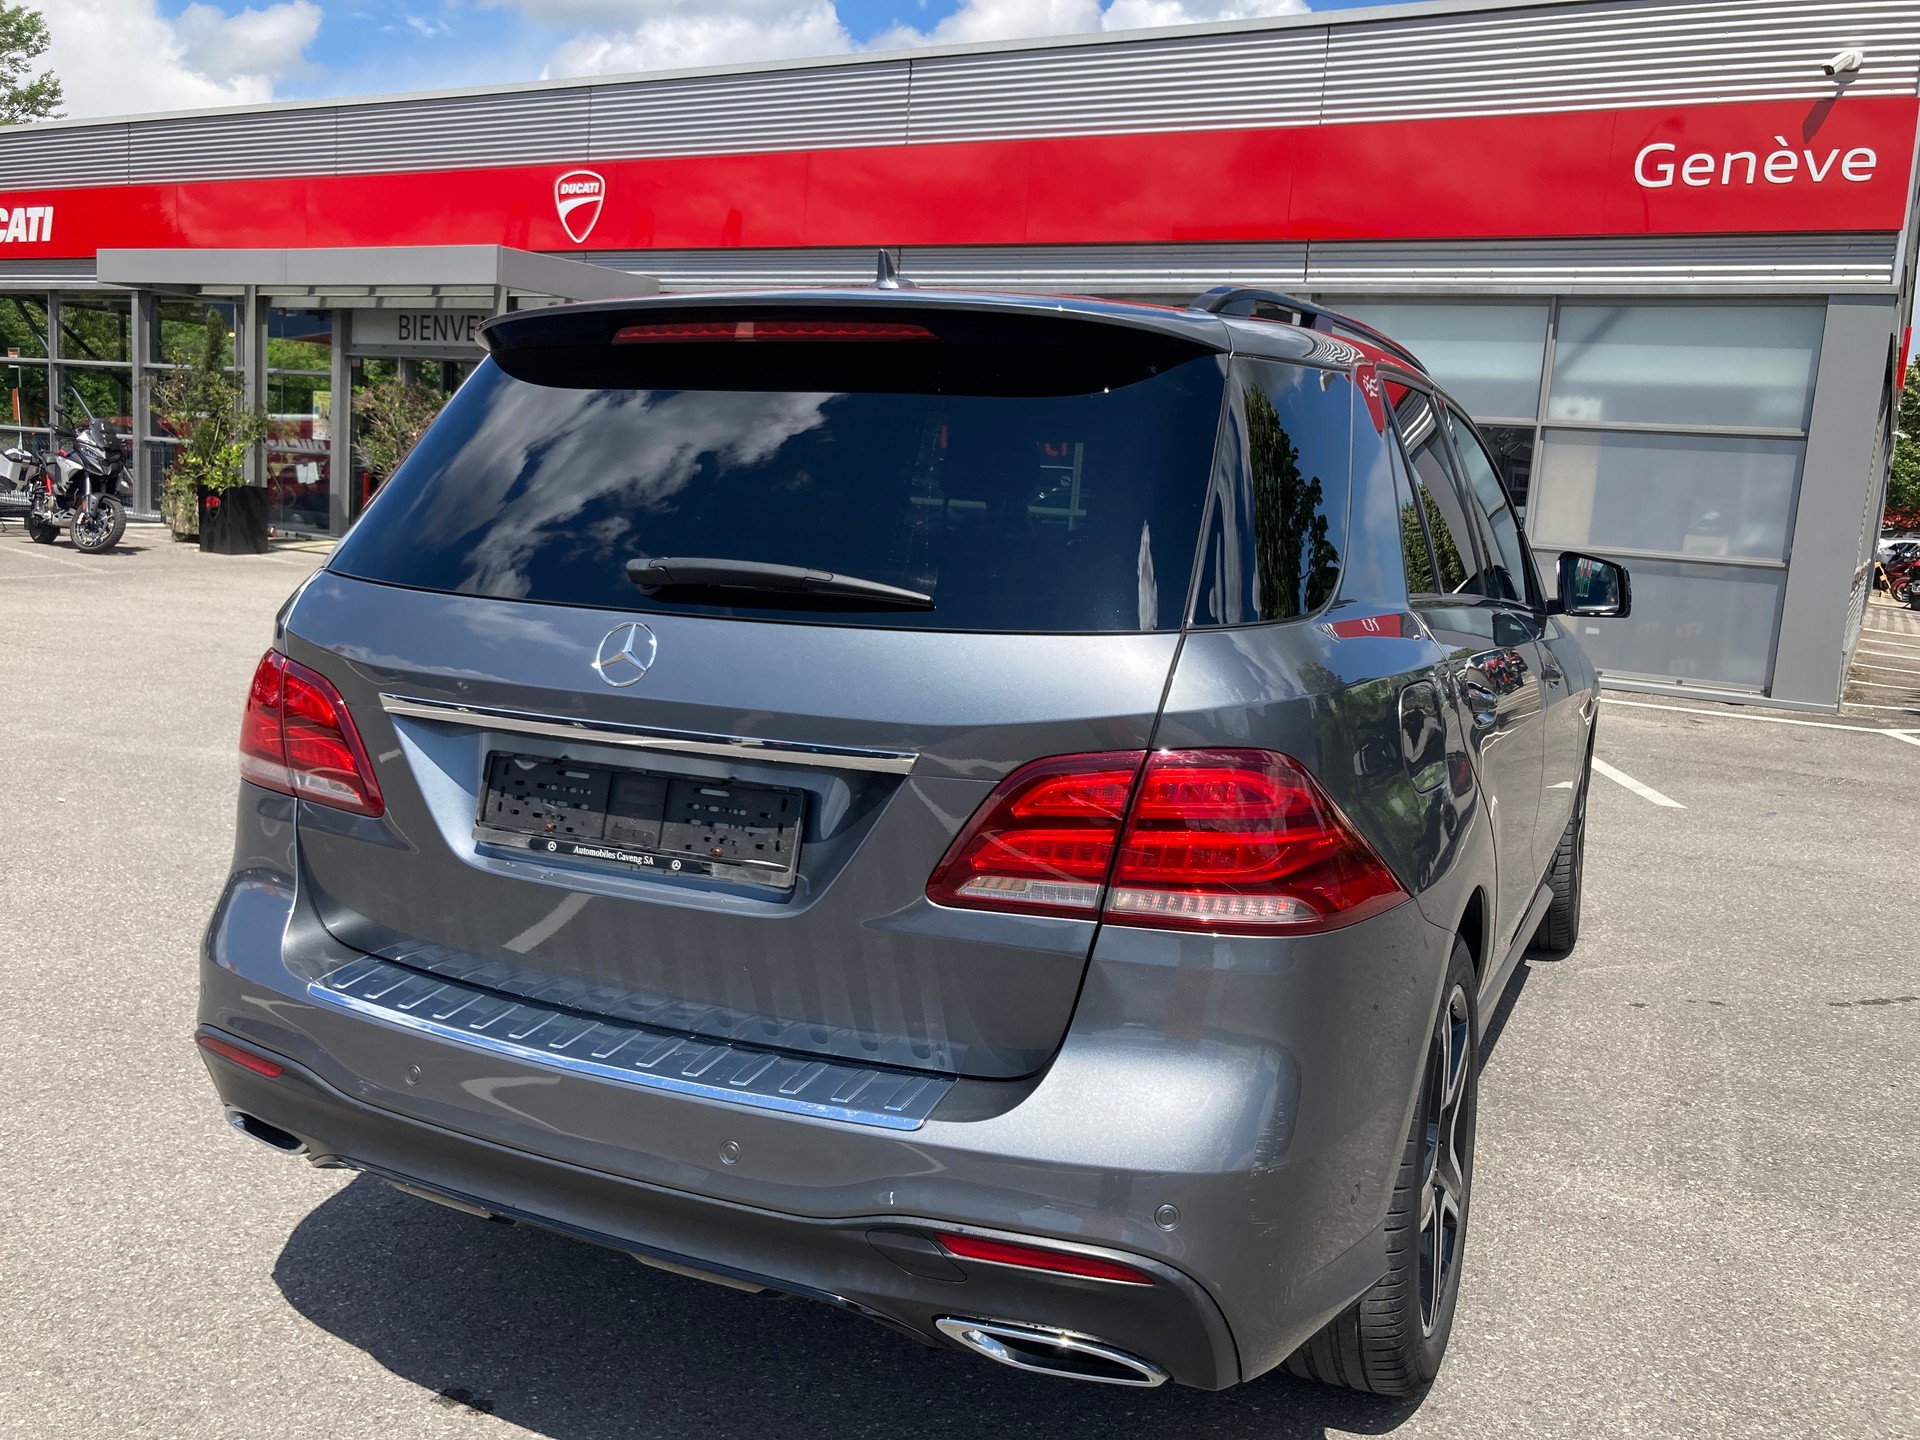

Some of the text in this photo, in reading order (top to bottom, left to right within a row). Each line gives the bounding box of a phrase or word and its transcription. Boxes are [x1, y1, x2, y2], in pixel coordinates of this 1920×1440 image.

[1634, 135, 1877, 188] Genève
[560, 182, 600, 195] DUCATI
[398, 314, 486, 342] BIENVE
[573, 845, 654, 865] Automobiles Caveng SA
